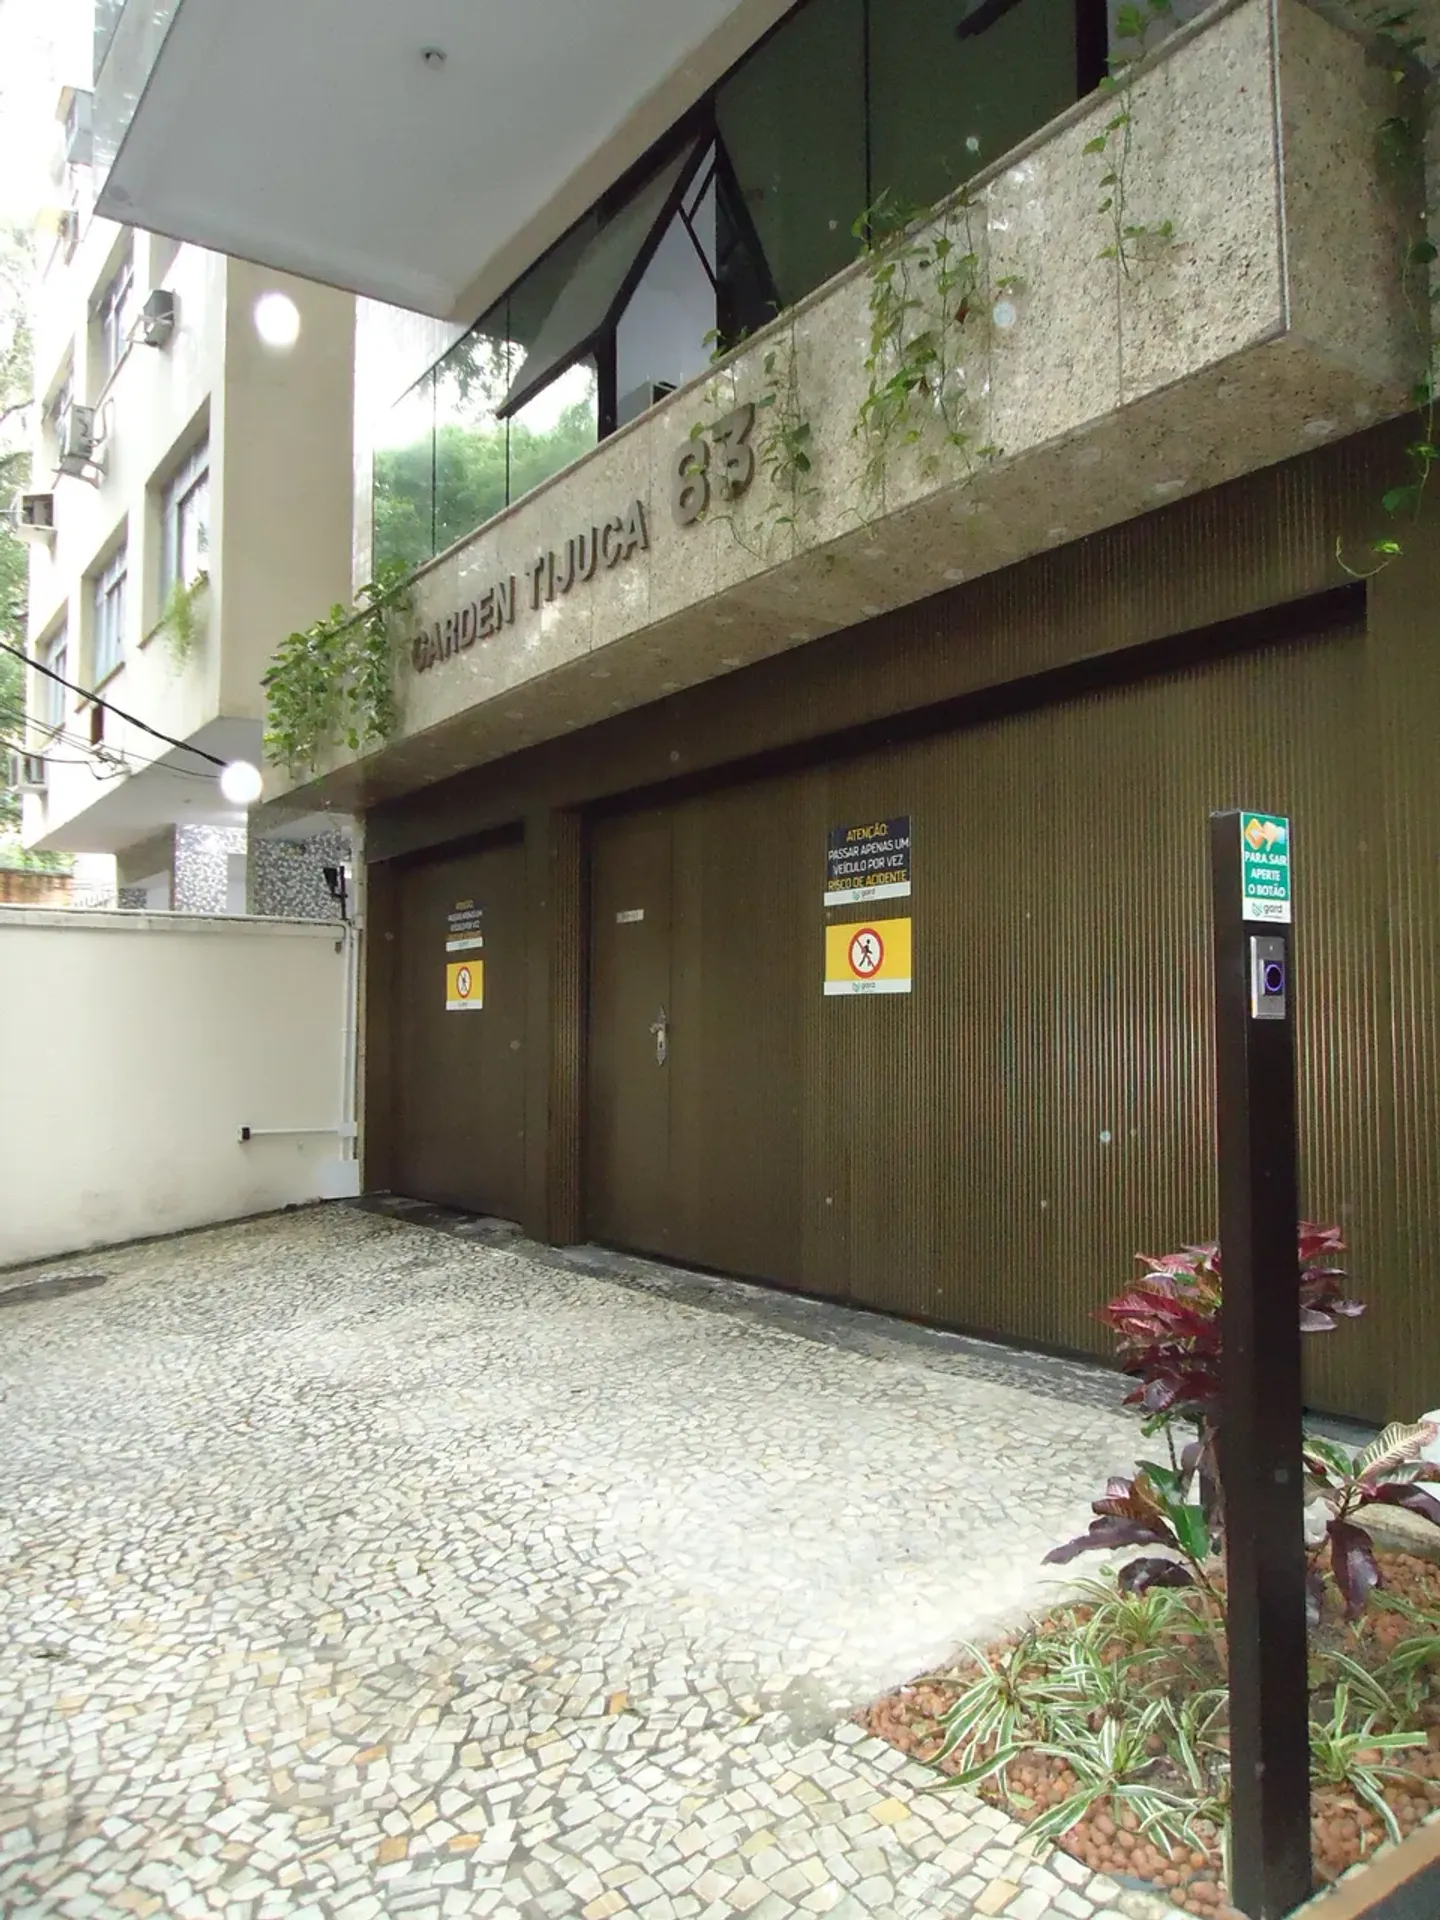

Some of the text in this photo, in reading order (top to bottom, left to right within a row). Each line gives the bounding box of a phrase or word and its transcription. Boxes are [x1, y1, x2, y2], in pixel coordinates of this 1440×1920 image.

[524, 497, 650, 611] TIJUCA
[671, 402, 756, 527] 83
[828, 837, 910, 861] PASSAR APENAS UM
[1244, 851, 1288, 866] PARA SAIR
[832, 853, 904, 875] VEÍCULO POR VEZ
[1250, 868, 1281, 881] APERTE
[828, 869, 907, 891] RISCO DE ACIDENTE
[1248, 882, 1286, 898] O BOTÃO
